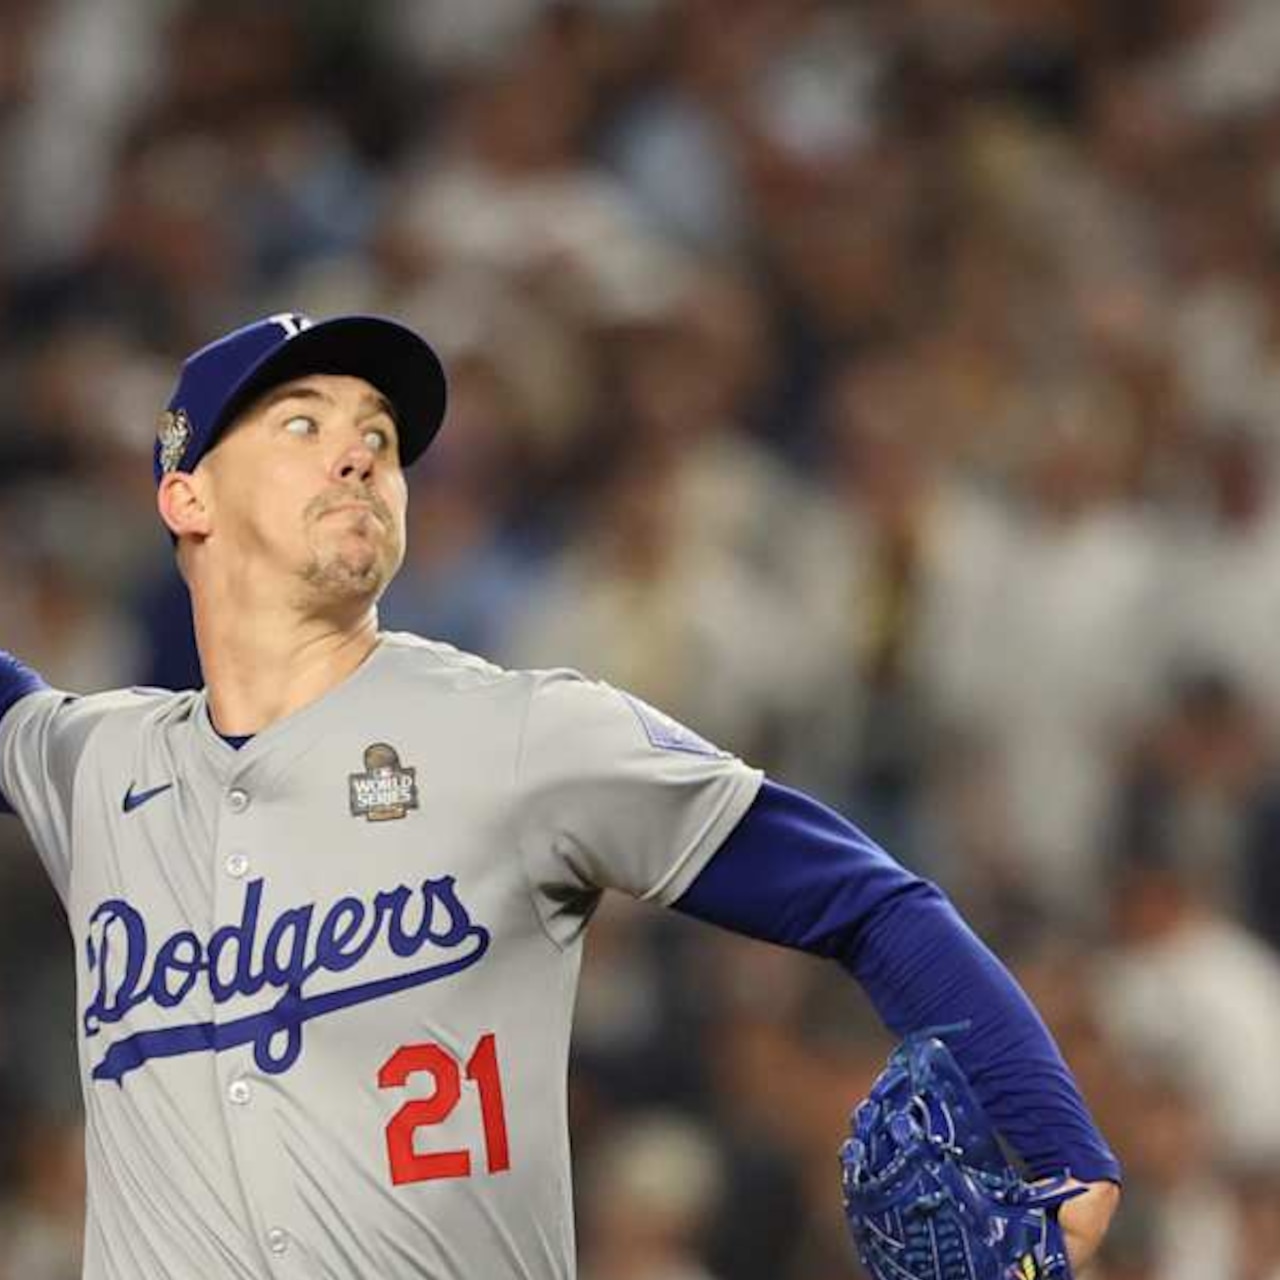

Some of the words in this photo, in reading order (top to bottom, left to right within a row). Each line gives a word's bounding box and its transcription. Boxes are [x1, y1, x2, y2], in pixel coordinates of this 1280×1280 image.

[354, 775, 413, 795] WORLD
[356, 786, 412, 808] SERIES
[83, 875, 490, 1086] Dodgers
[377, 1034, 510, 1186] 21
